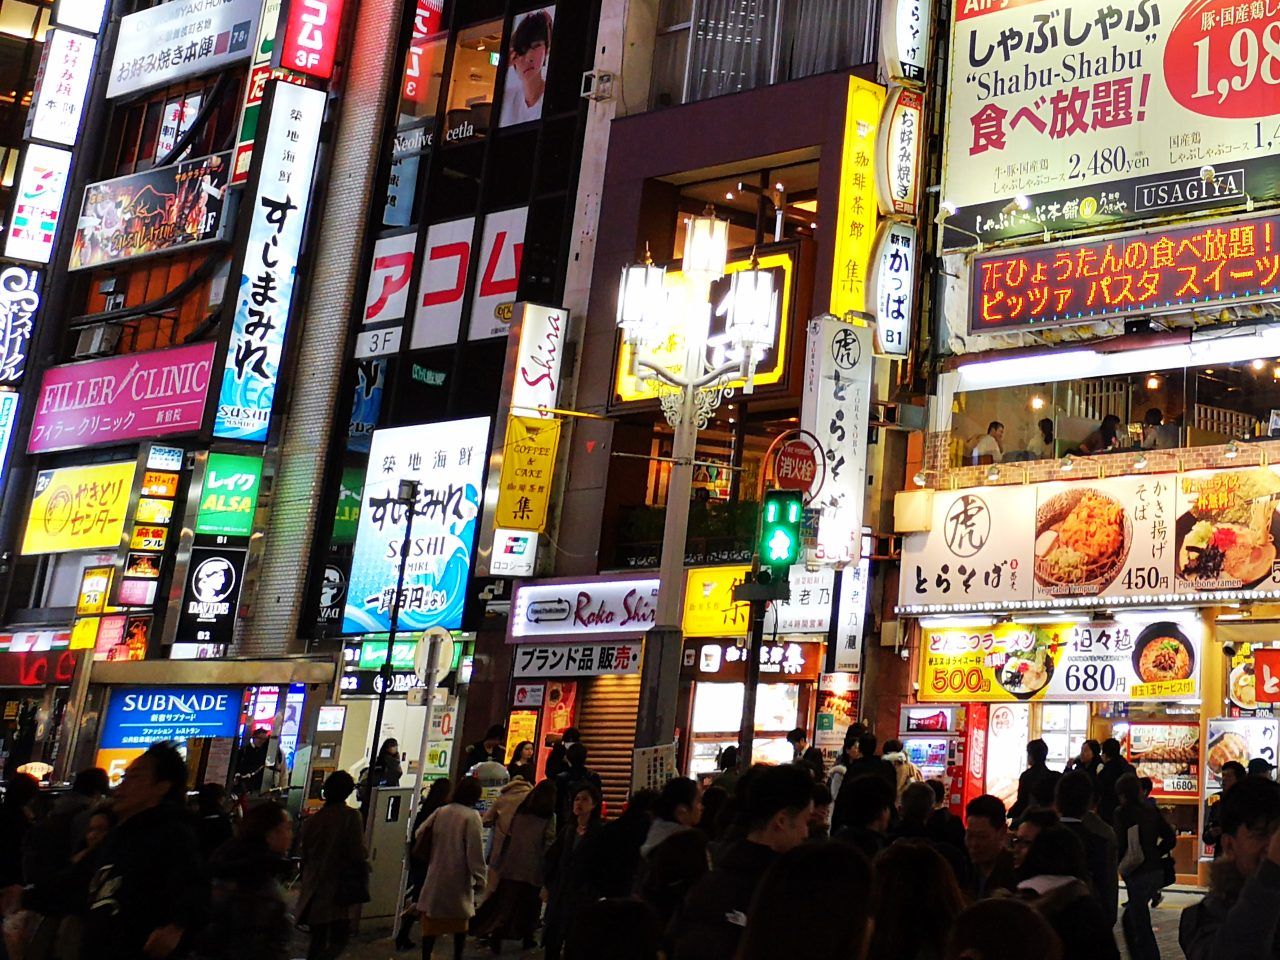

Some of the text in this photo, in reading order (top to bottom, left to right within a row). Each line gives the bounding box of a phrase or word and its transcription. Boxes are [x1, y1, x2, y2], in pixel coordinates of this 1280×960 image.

[116, 34, 215, 83] お好み焼き本陣
[294, 50, 320, 70] 3F
[446, 121, 474, 141] cetla
[1169, 131, 1201, 148] 国産鶏
[896, 110, 915, 200] お好み焼き
[1068, 145, 1150, 181] 2,480 yen
[1168, 140, 1250, 165] しゃぶしゃぶコース
[849, 150, 870, 240] 珈琲茶館
[992, 172, 1066, 194] しゃぶしゃぶコース
[1142, 176, 1239, 208] USAGIYA
[234, 195, 298, 380] すしまみれ
[365, 230, 525, 320] アコム
[841, 258, 863, 294] 集
[885, 248, 909, 320] かっぱ
[981, 253, 1280, 322] ピッツァ パスタ スイーツ
[369, 330, 394, 353] 3F
[833, 328, 858, 366] 虎
[885, 330, 903, 346] B1
[41, 360, 209, 416] FILLER CLINIC
[33, 410, 136, 442] フィラークリニック
[220, 404, 269, 422] SUSHI
[382, 445, 474, 474] 築地海鮮
[513, 444, 551, 457] COFFEE
[207, 470, 255, 492] レイク
[514, 467, 543, 479] CAKE
[779, 455, 815, 481] 消火栓
[74, 478, 124, 508] やきとり
[201, 493, 252, 513] ALSA
[1134, 484, 1149, 523] そば
[70, 508, 118, 537] センター
[512, 496, 534, 521] 集
[949, 494, 985, 551] 虎
[1150, 480, 1169, 560] かき揚げ
[492, 560, 532, 571] ロコシーラ
[914, 559, 1008, 595] とらそば
[1121, 565, 1170, 590] 450円
[188, 601, 229, 615] DAVIDE
[520, 644, 593, 672] ブランド品
[931, 669, 991, 693] 500円
[1064, 663, 1126, 692] 680円
[122, 694, 229, 713] SUBNADE
